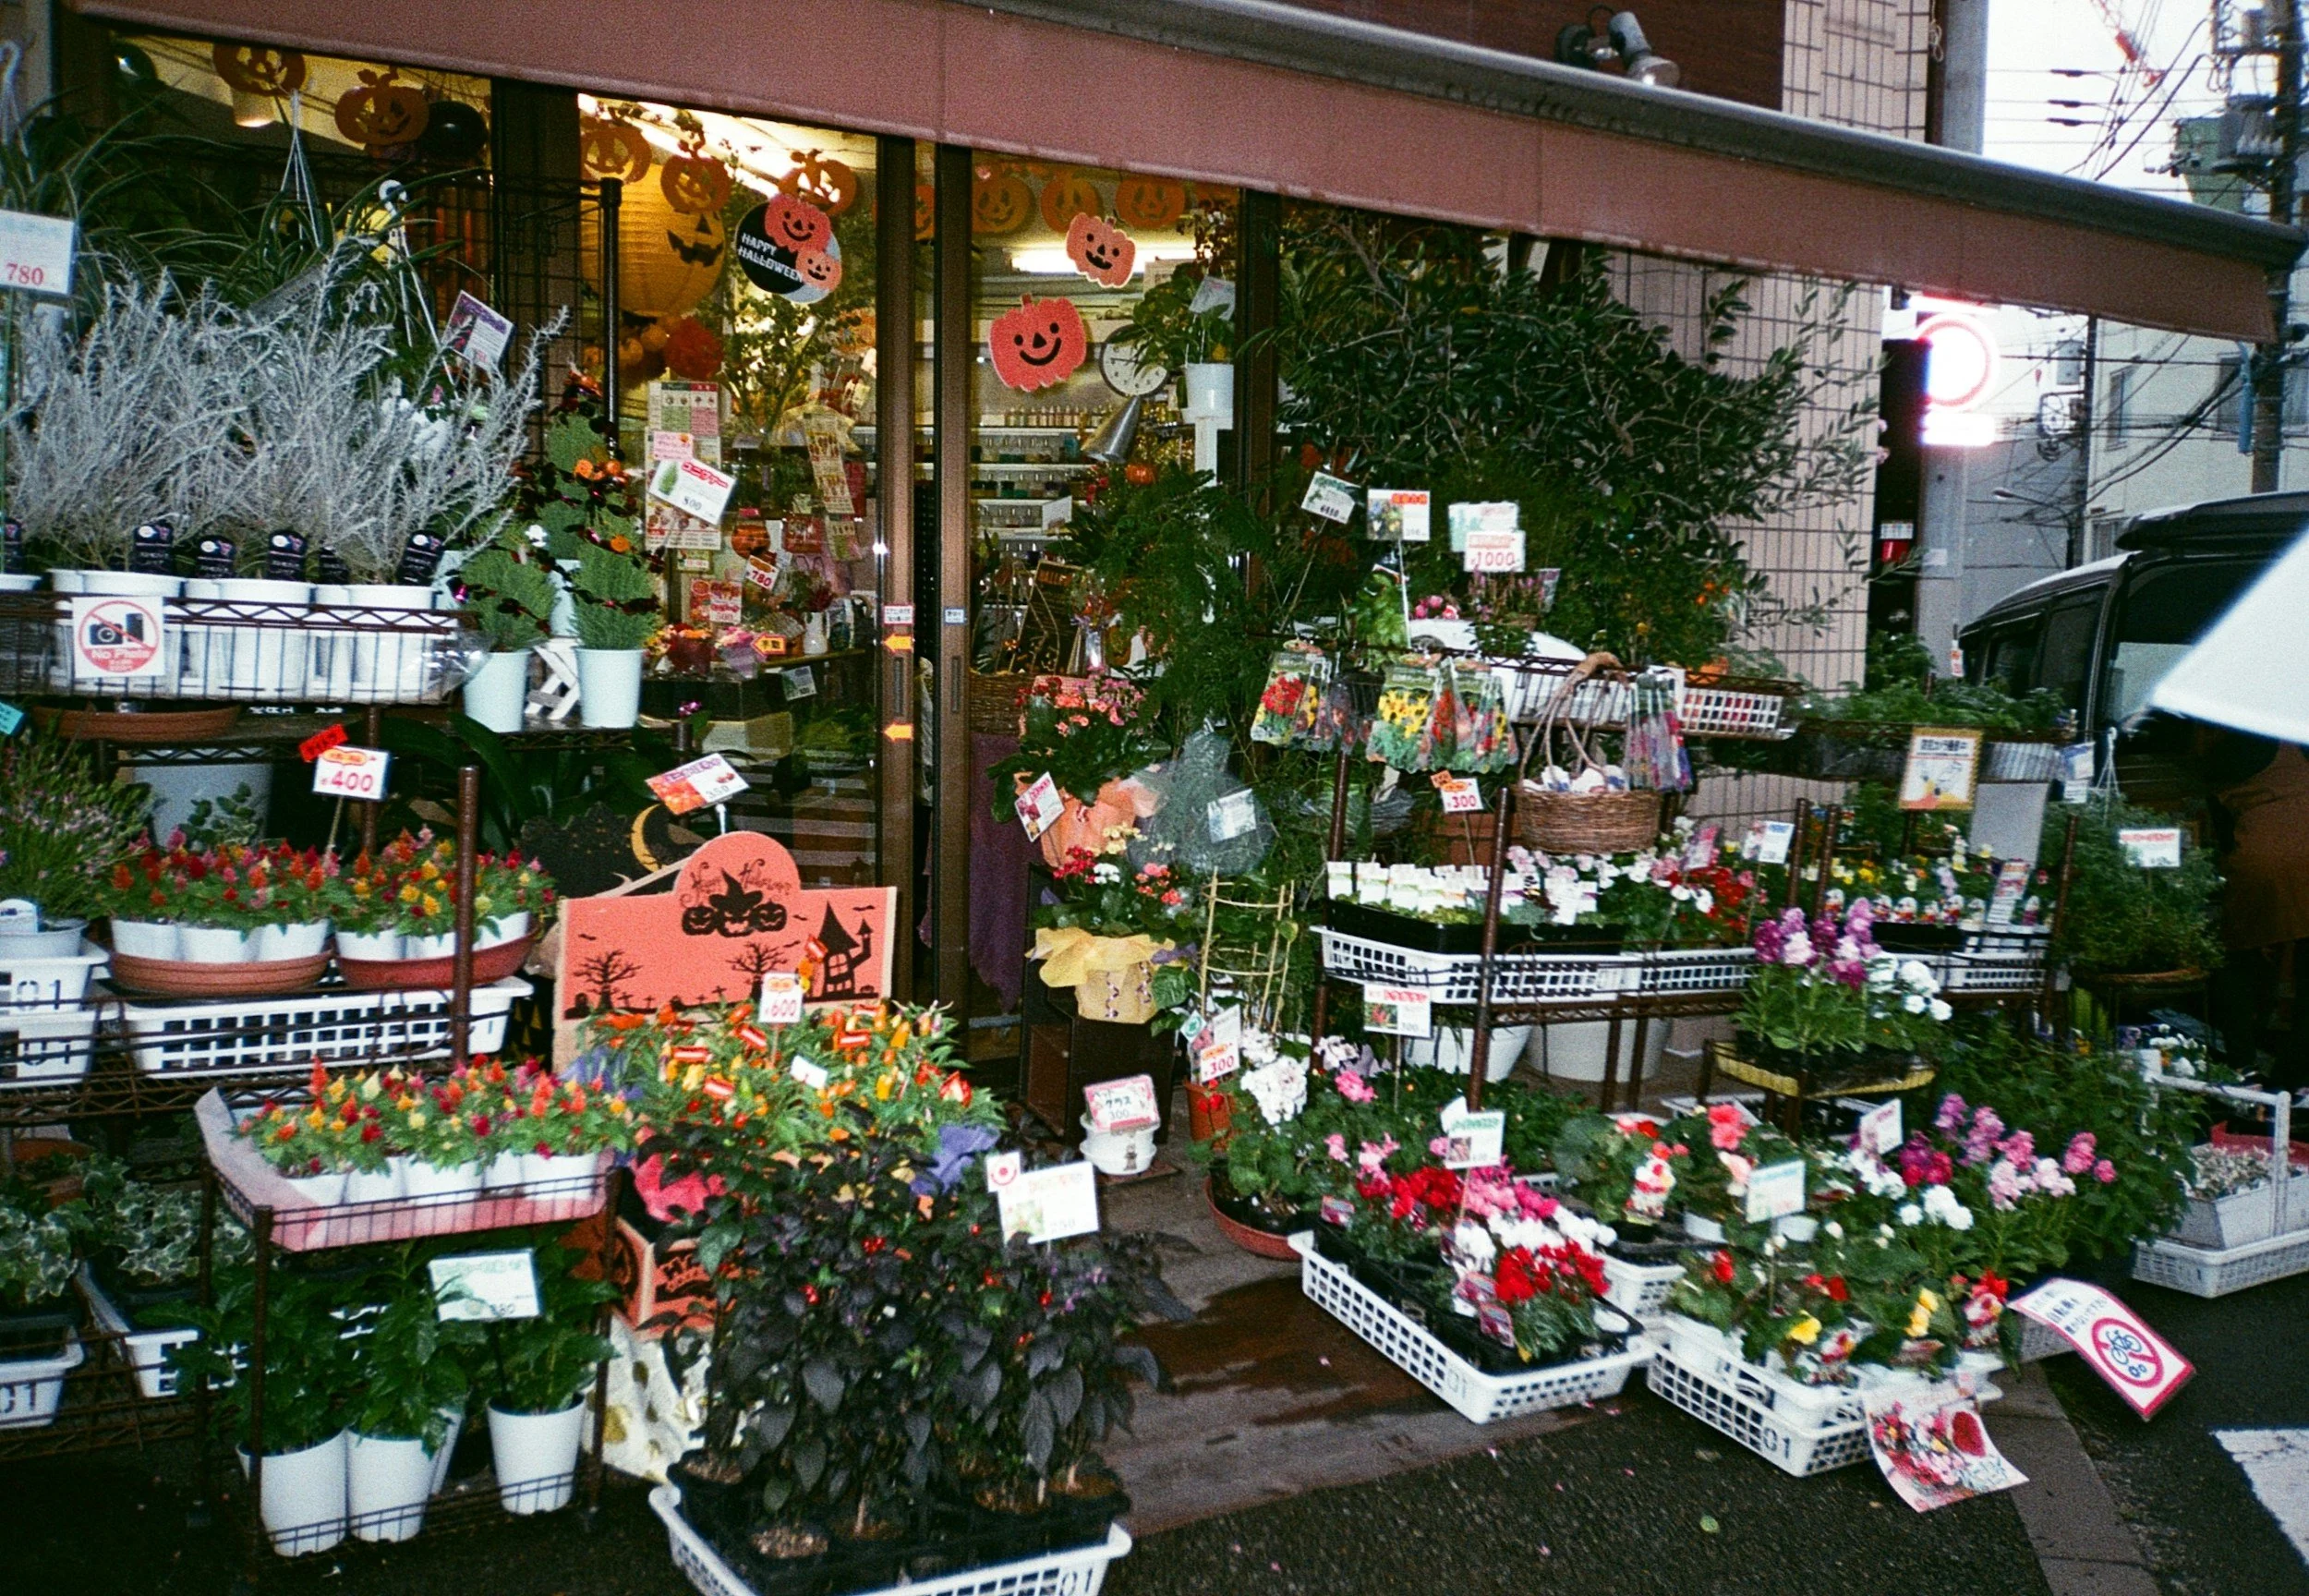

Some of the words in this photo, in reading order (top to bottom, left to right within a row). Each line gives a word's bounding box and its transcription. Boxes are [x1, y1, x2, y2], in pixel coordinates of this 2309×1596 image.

[741, 232, 778, 256] HAPPY
[6, 261, 44, 285] 780
[92, 647, 113, 659] No
[1762, 1426, 1791, 1460] 01
